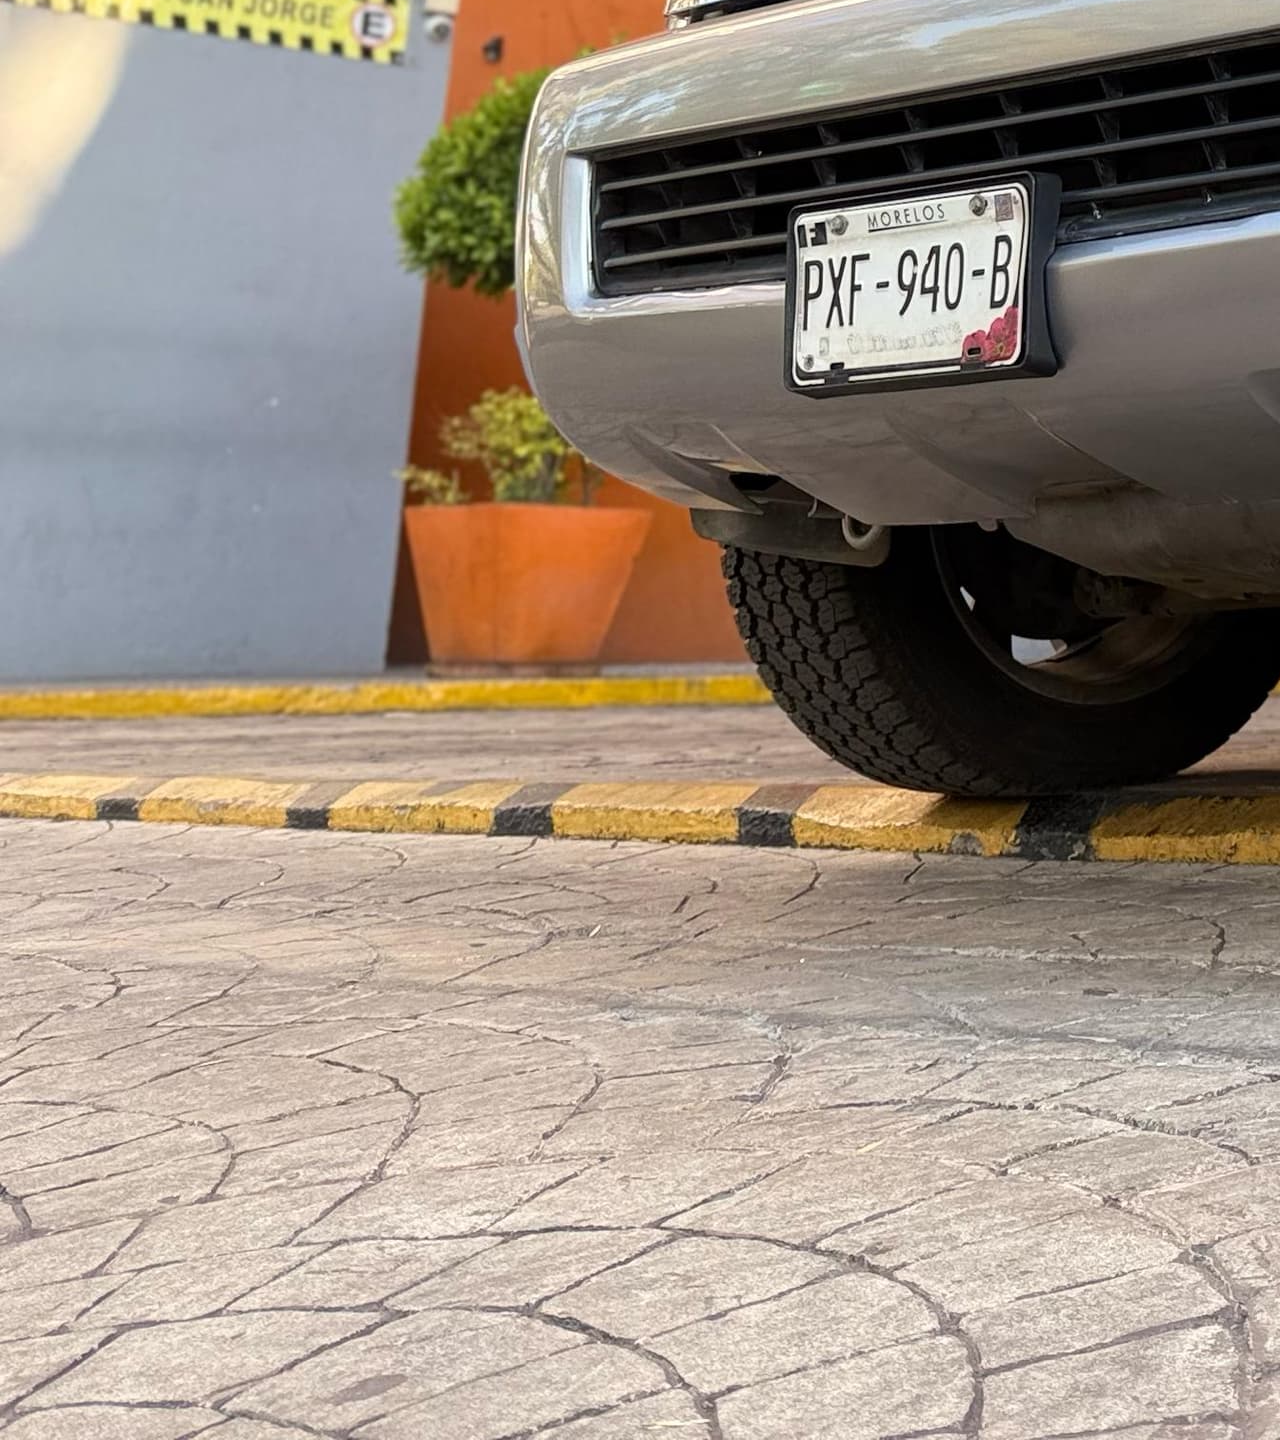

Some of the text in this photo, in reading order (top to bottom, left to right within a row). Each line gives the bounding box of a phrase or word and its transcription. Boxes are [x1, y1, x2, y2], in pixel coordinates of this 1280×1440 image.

[359, 10, 386, 38] E
[867, 203, 946, 229] MORELOS
[802, 234, 1013, 332] PXF-940-B
